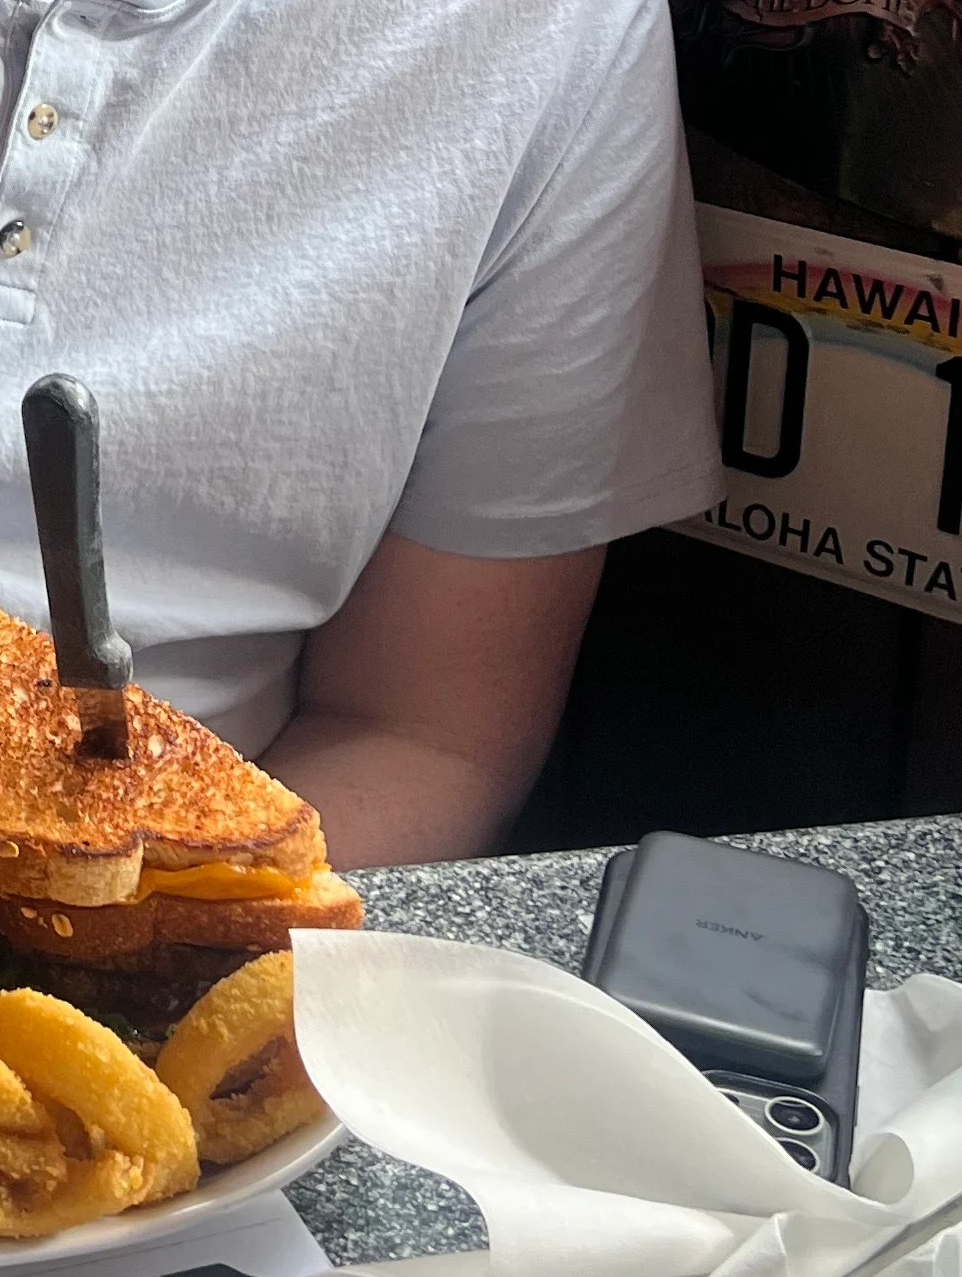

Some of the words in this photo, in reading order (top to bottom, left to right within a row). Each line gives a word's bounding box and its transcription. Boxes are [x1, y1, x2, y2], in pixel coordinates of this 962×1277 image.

[772, 254, 961, 338] HAWAI
[705, 298, 810, 478] D
[703, 495, 844, 565] LOHA
[863, 539, 962, 601] STA
[695, 918, 765, 942] ANKER
